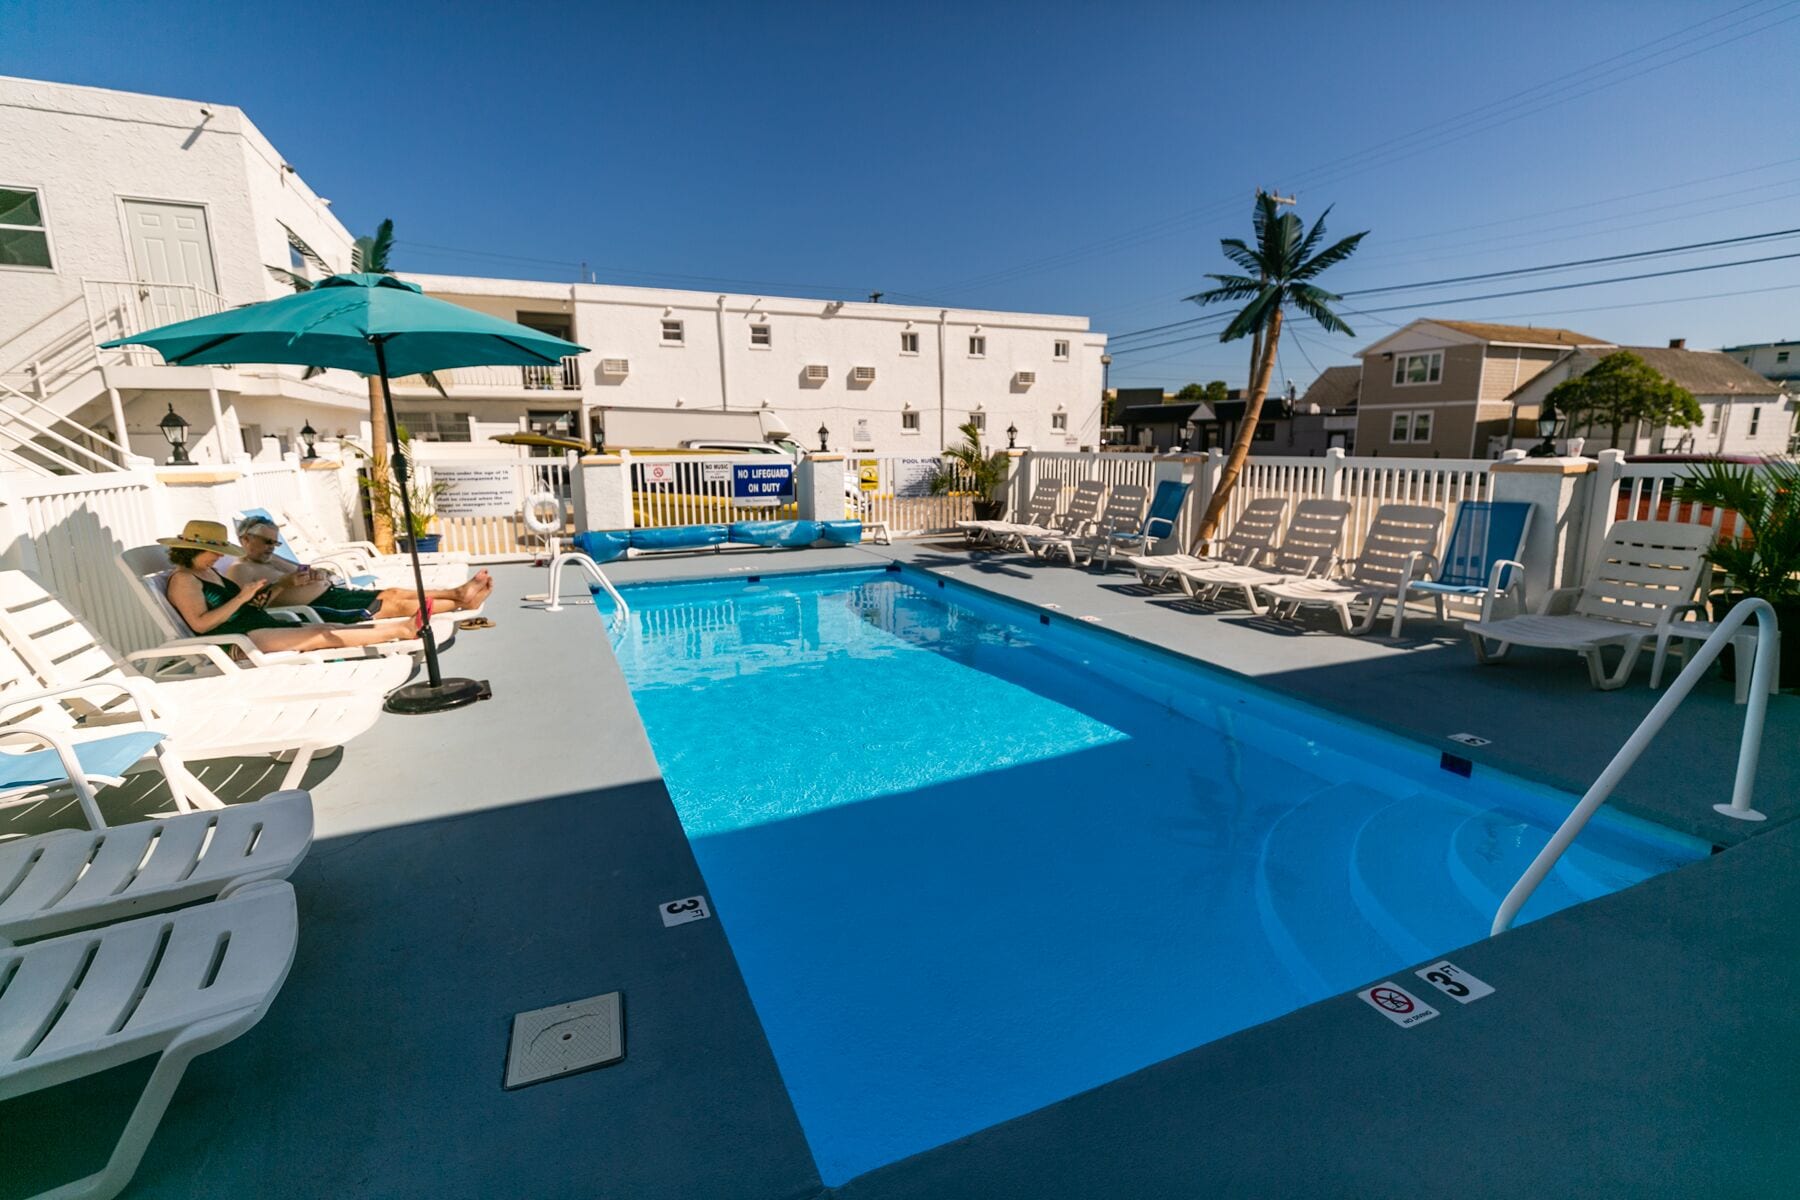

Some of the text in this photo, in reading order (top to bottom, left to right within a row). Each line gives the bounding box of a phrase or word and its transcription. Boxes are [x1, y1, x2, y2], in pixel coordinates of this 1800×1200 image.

[738, 468, 789, 479] NO LIFEGUARD
[748, 482, 780, 492] ON DUTY
[666, 900, 704, 918] 3 FT
[1426, 965, 1470, 996] 3 FT
[1412, 1010, 1432, 1020] DIVING
